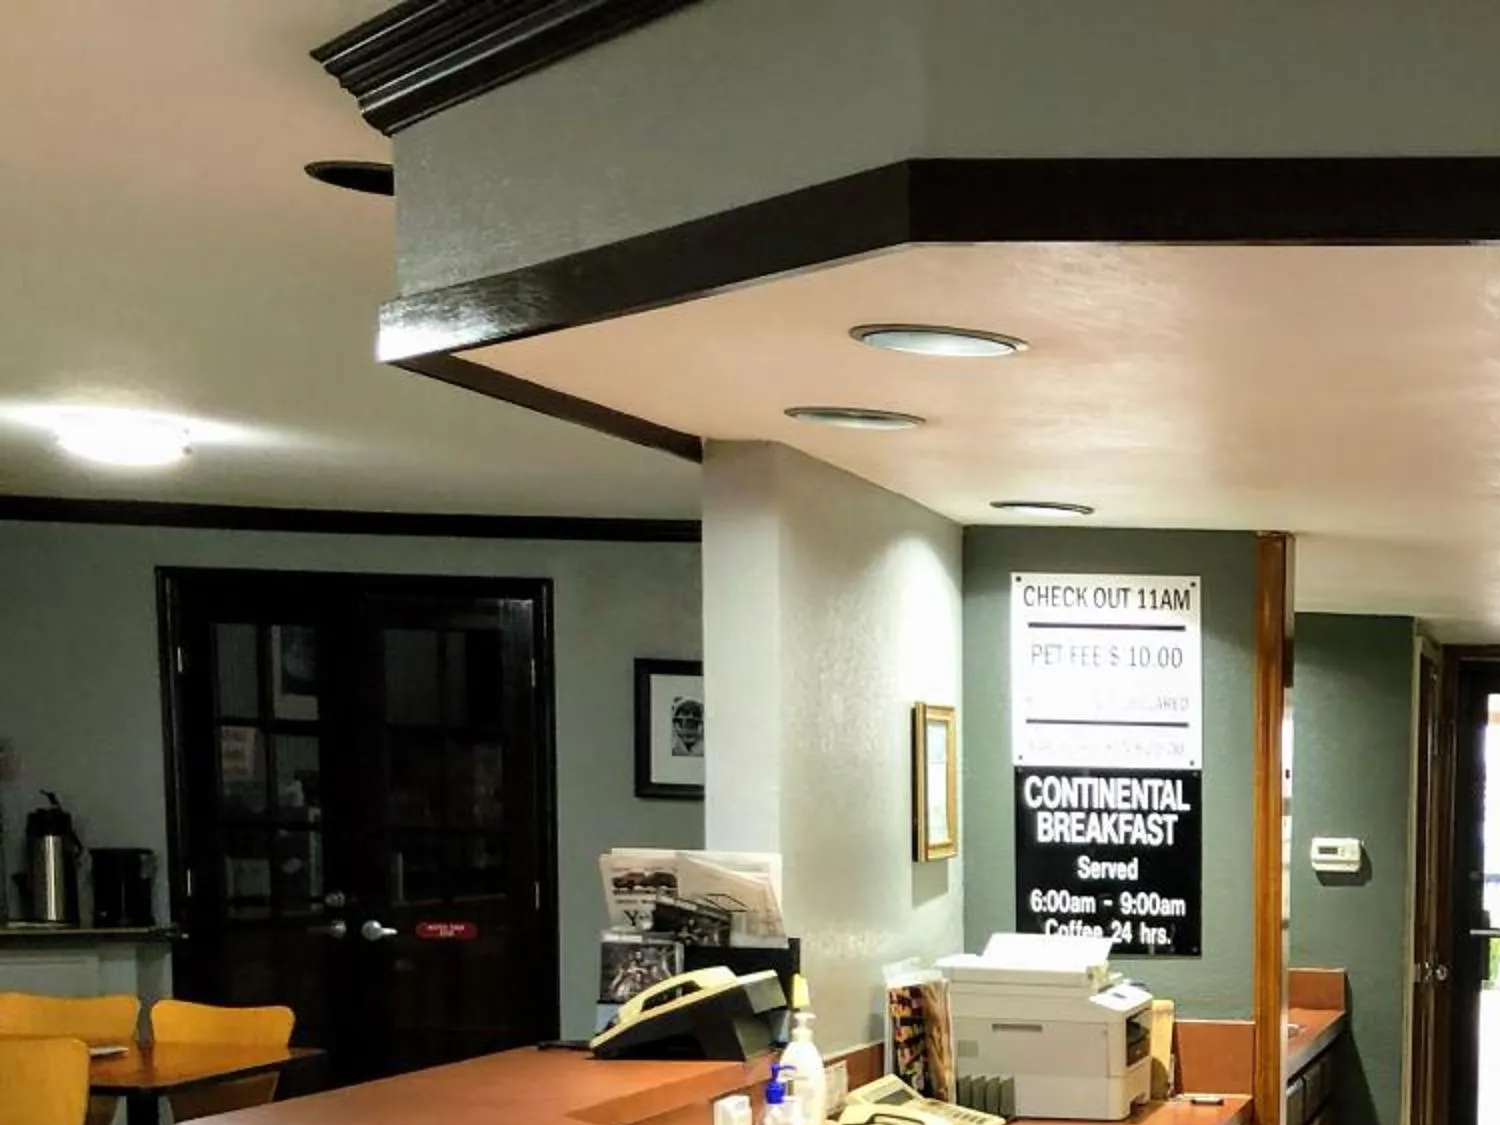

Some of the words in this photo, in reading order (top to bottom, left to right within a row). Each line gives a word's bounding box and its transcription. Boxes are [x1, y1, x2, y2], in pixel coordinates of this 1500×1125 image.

[1023, 584, 1089, 609] CHECK
[1093, 586, 1132, 609] OUT
[1137, 586, 1192, 611] 11AM
[1031, 643, 1063, 667] PET
[1070, 645, 1102, 668] FEE
[1024, 775, 1191, 812] CONTINENTAL
[1036, 812, 1179, 846] BREAKFAST
[1077, 855, 1139, 881] Served
[1030, 889, 1096, 915] 6:00am
[1120, 891, 1187, 917] 9:00am
[1045, 918, 1104, 938] Coffee
[1111, 920, 1133, 944] 24
[1140, 921, 1172, 945] hrs.
